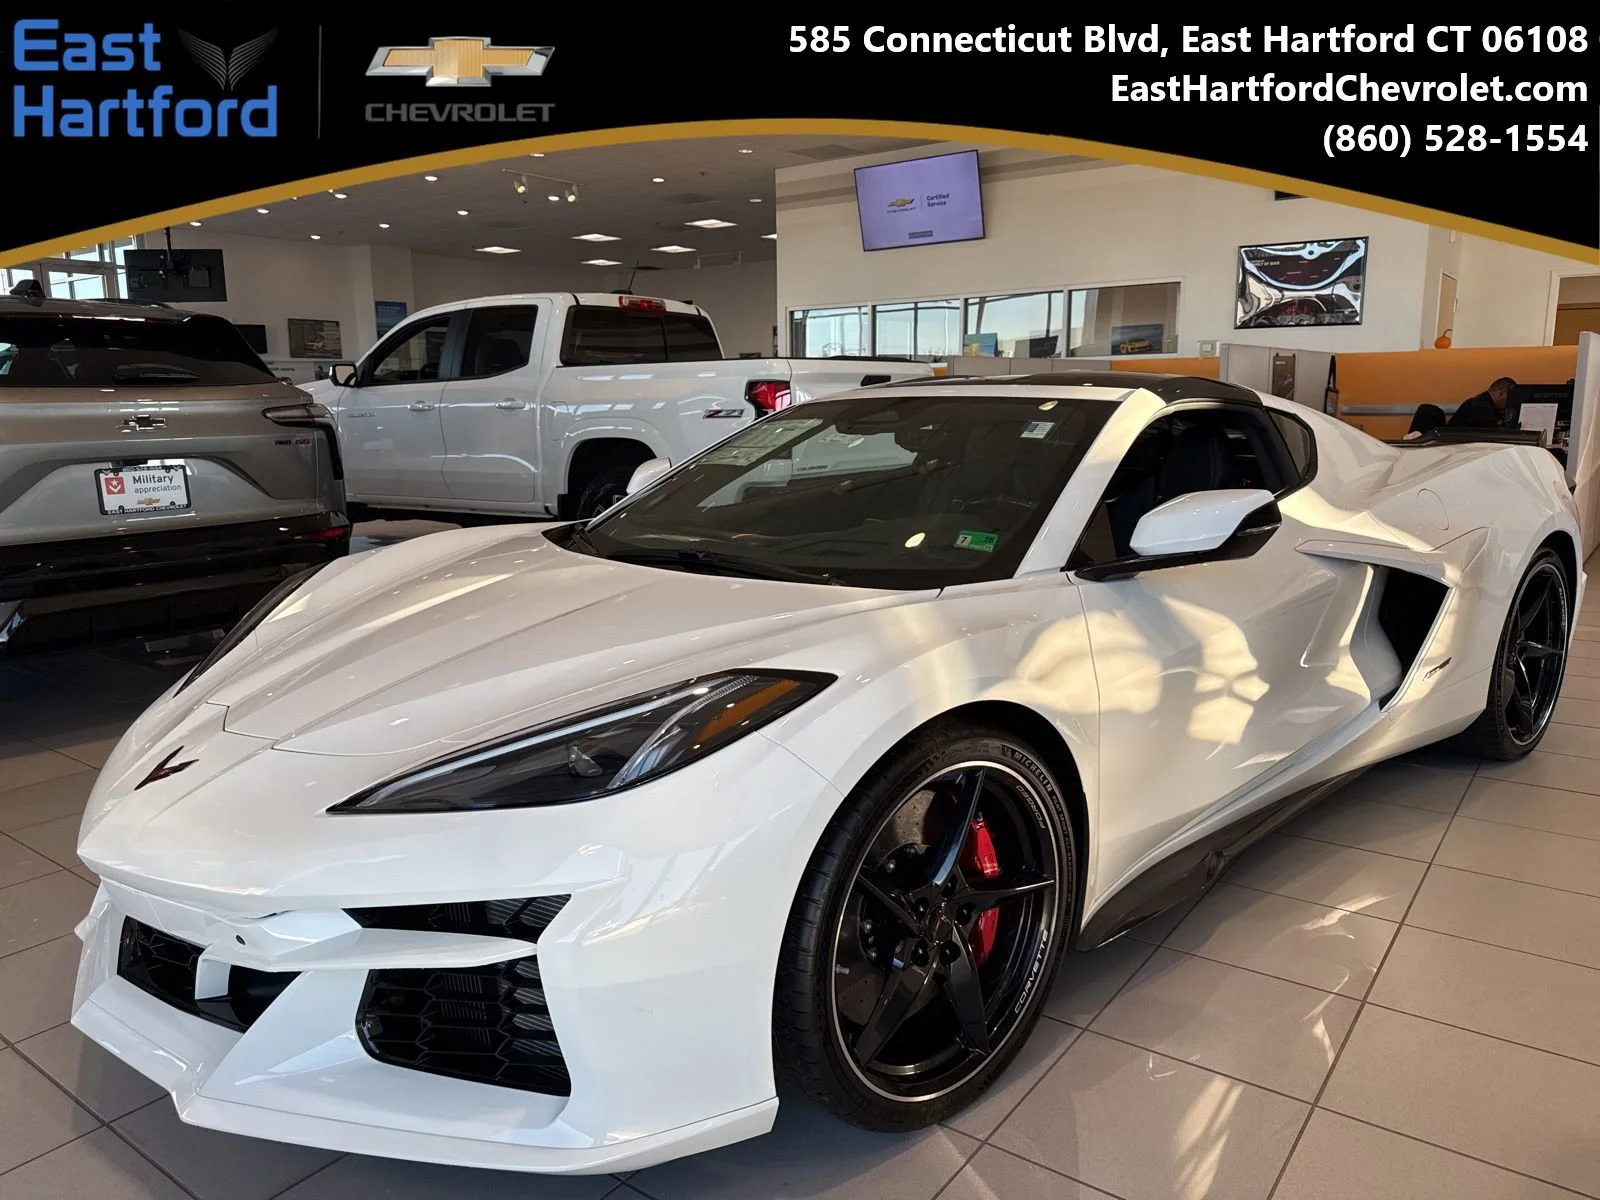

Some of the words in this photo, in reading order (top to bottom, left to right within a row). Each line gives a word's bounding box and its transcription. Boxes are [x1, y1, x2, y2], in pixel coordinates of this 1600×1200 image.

[926, 193, 950, 201] Certified
[703, 409, 745, 419] Z71
[132, 475, 174, 485] Military
[134, 484, 182, 494] appreciation
[124, 506, 155, 514] HARTFORD
[960, 535, 968, 544] 7
[1014, 751, 1054, 795] MICHELIN
[1016, 785, 1046, 829] FORGED
[1014, 928, 1049, 1014] CORVETTE
